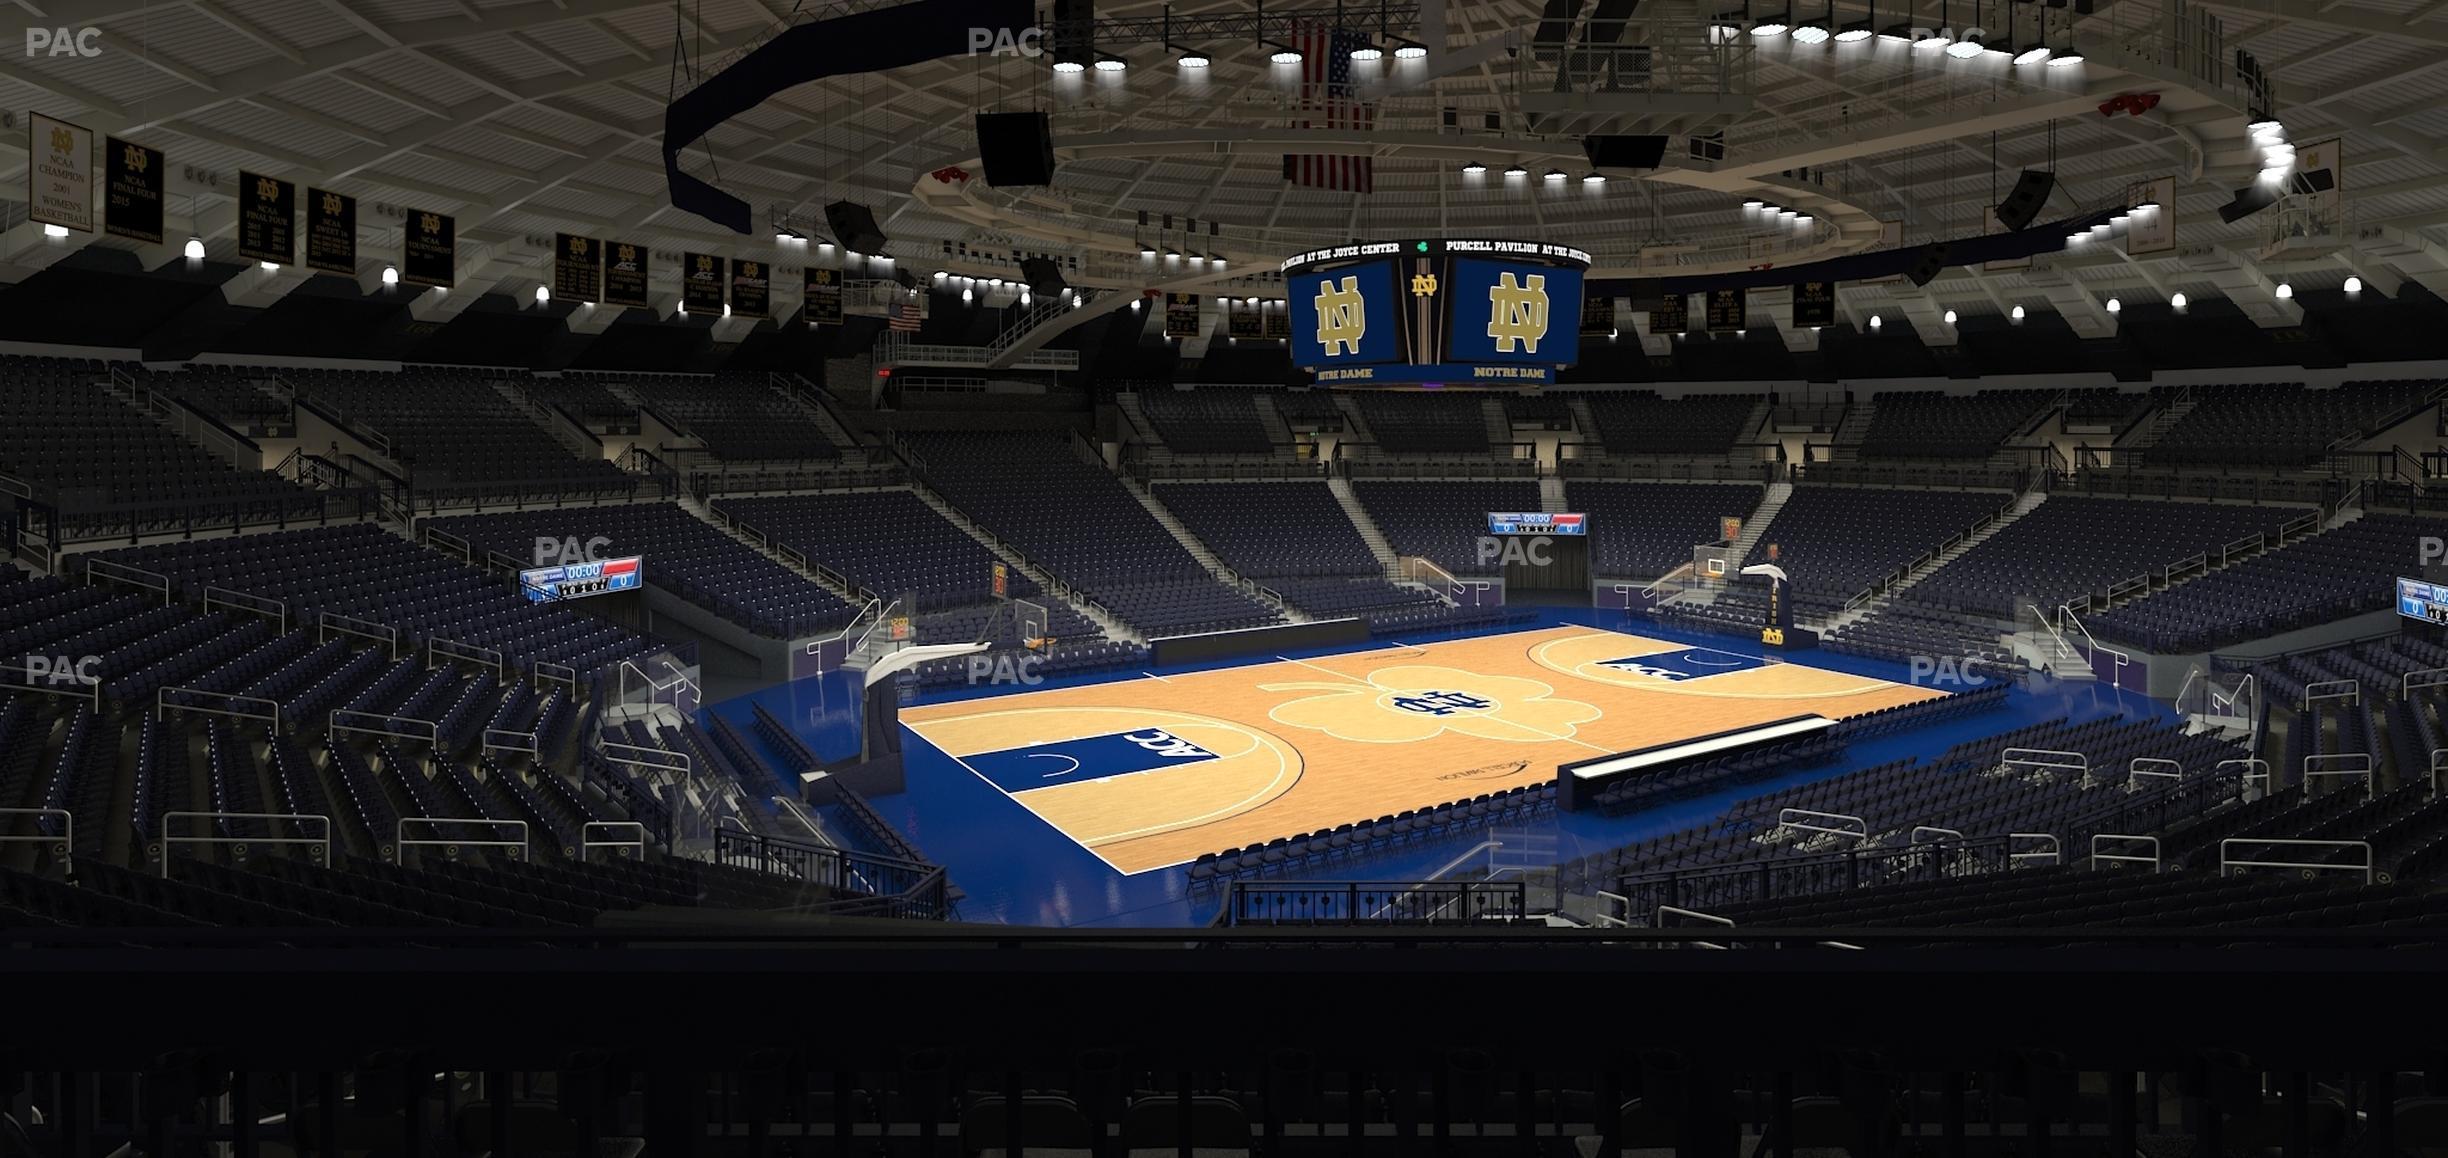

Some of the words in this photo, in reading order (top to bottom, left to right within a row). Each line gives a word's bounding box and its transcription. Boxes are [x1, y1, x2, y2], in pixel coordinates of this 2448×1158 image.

[50, 155, 74, 169] NCAA
[39, 164, 85, 183] CHAMPION
[112, 180, 136, 194] FINAL
[124, 174, 147, 188] NCAA
[53, 183, 71, 195] 2001
[42, 195, 82, 212] WOMEN'S
[34, 207, 88, 225] BASKETBALL
[1307, 251, 1316, 262] AT
[1317, 249, 1331, 260] THE
[1333, 246, 1359, 258] JOYCE
[1361, 243, 1400, 255] CENTER
[1446, 241, 1493, 251] PURCELL
[1494, 241, 1538, 253] PAVILION
[1542, 244, 1553, 255] AT
[1554, 246, 1567, 256] THE
[1340, 368, 1373, 378] DAME
[1474, 367, 1518, 377] NOTRE
[1520, 368, 1545, 378] DAME
[1524, 514, 1550, 523] 00:00
[568, 564, 600, 579] 00:00
[620, 576, 627, 586] 0
[2412, 602, 2418, 614] 0
[1123, 731, 1215, 757] ACC
